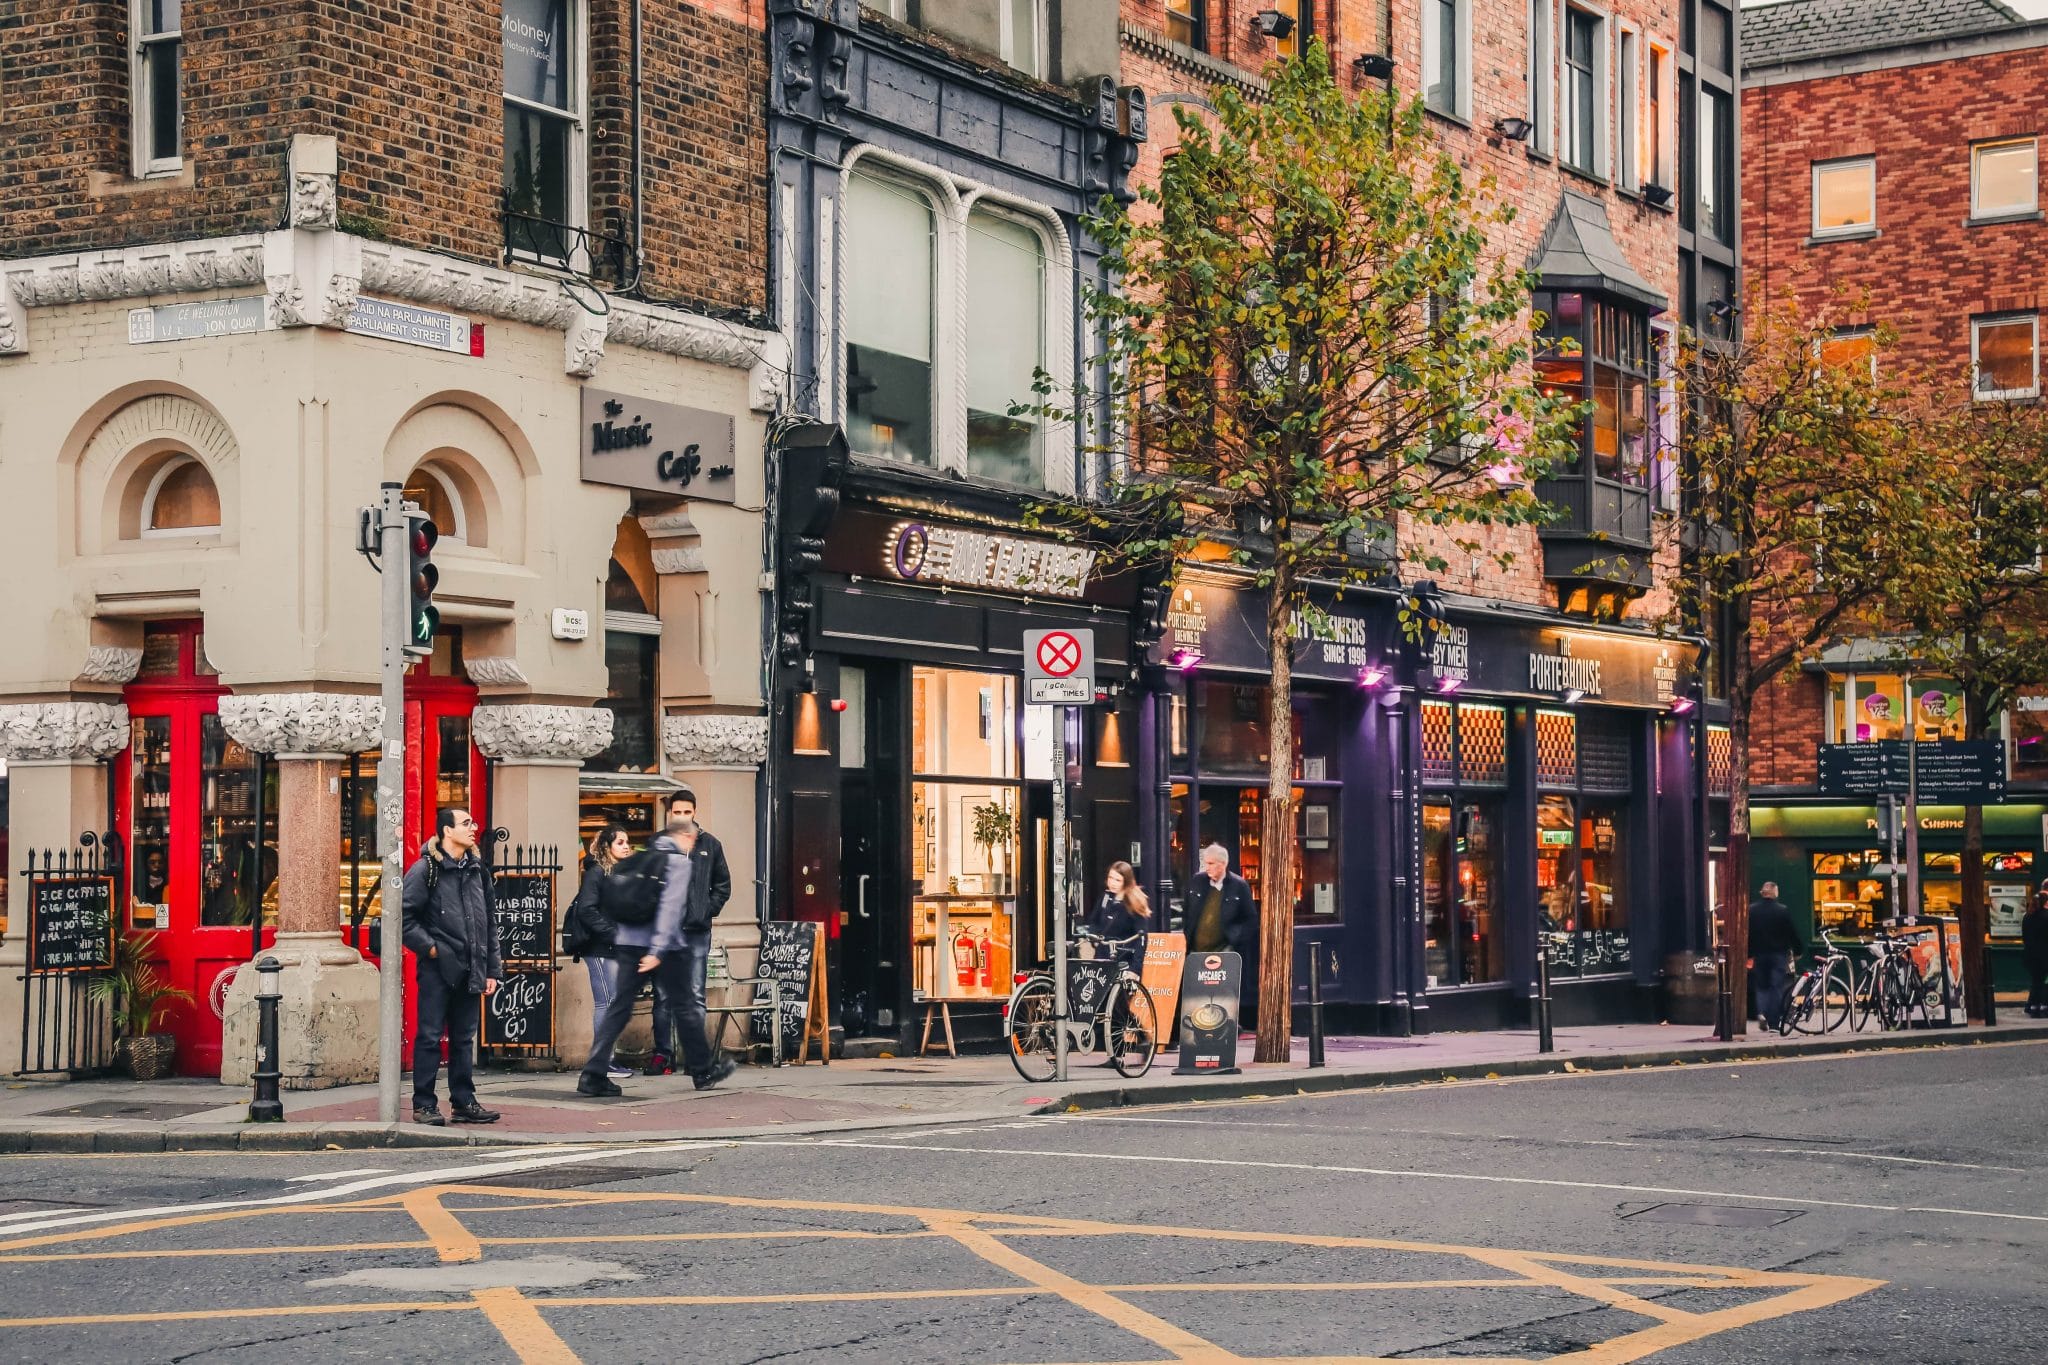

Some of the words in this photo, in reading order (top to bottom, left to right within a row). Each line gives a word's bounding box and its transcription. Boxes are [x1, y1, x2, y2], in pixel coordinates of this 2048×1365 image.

[502, 14, 551, 47] Moloney
[506, 39, 530, 56] Notary
[230, 316, 257, 330] QUAY
[352, 300, 375, 315] RÁID
[377, 307, 391, 318] NA
[392, 309, 450, 330] PARLAIMINTE
[349, 315, 408, 336] PARLIAMENT
[411, 326, 447, 343] STREET
[456, 326, 464, 342] 2
[592, 414, 652, 454] Music
[924, 527, 951, 579] THE
[950, 530, 998, 586] INK
[991, 537, 1097, 598] FACTORY
[1167, 611, 1207, 632] PORTERHOUSE
[1290, 610, 1309, 639] AFT
[1323, 644, 1346, 664] SINCE
[1348, 648, 1367, 665] 1996
[1433, 645, 1446, 665] BY
[1447, 647, 1468, 668] MEN
[1560, 636, 1572, 656] THE
[1433, 665, 1443, 679] NOT
[1443, 667, 1469, 681] MACHINES
[1529, 653, 1602, 695] PORTERHOUSE
[1093, 686, 1108, 694] HONE
[1870, 706, 1892, 720] Yes
[1927, 704, 1949, 717] Yes
[1144, 950, 1182, 961] FACTORY
[492, 979, 546, 1016] Coffee
[754, 1018, 799, 1037] TAAS
